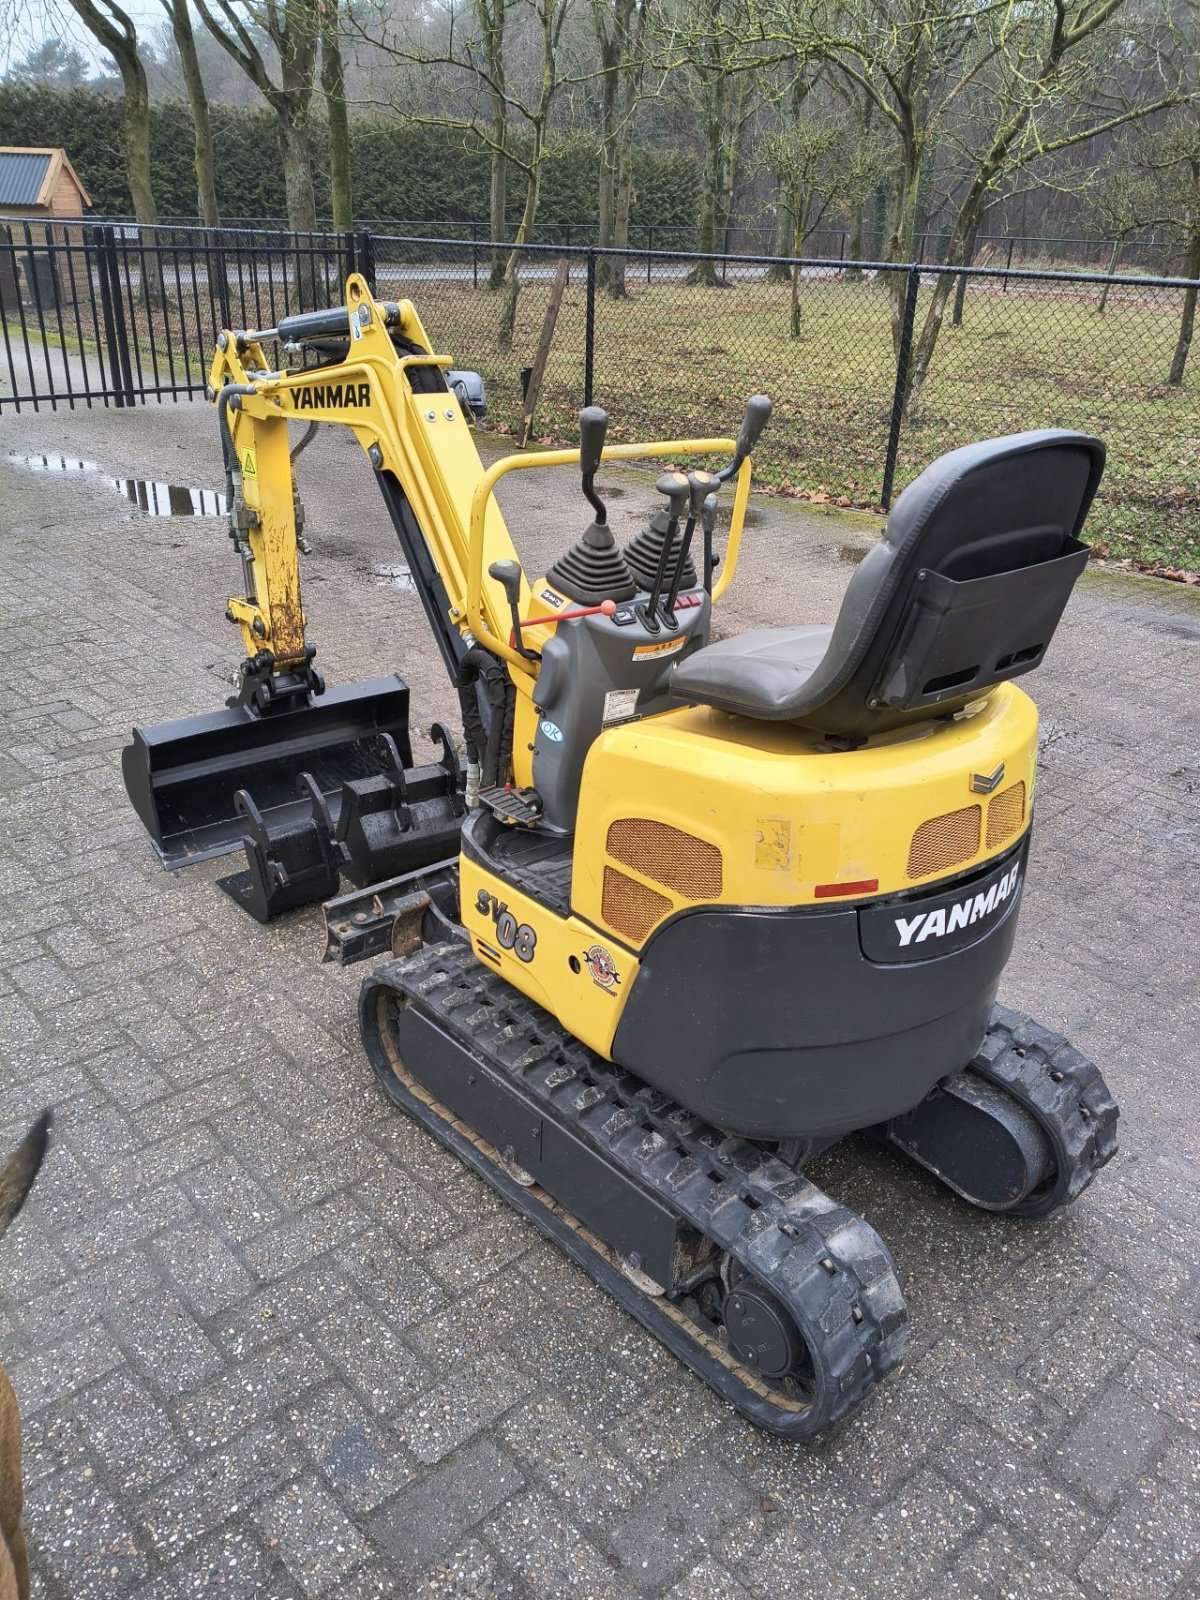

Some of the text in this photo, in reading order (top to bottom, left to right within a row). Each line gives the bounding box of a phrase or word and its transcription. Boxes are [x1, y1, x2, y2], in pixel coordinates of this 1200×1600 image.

[289, 383, 371, 409] YANMAR
[543, 723, 560, 741] OK
[894, 861, 1019, 946] YANMAR
